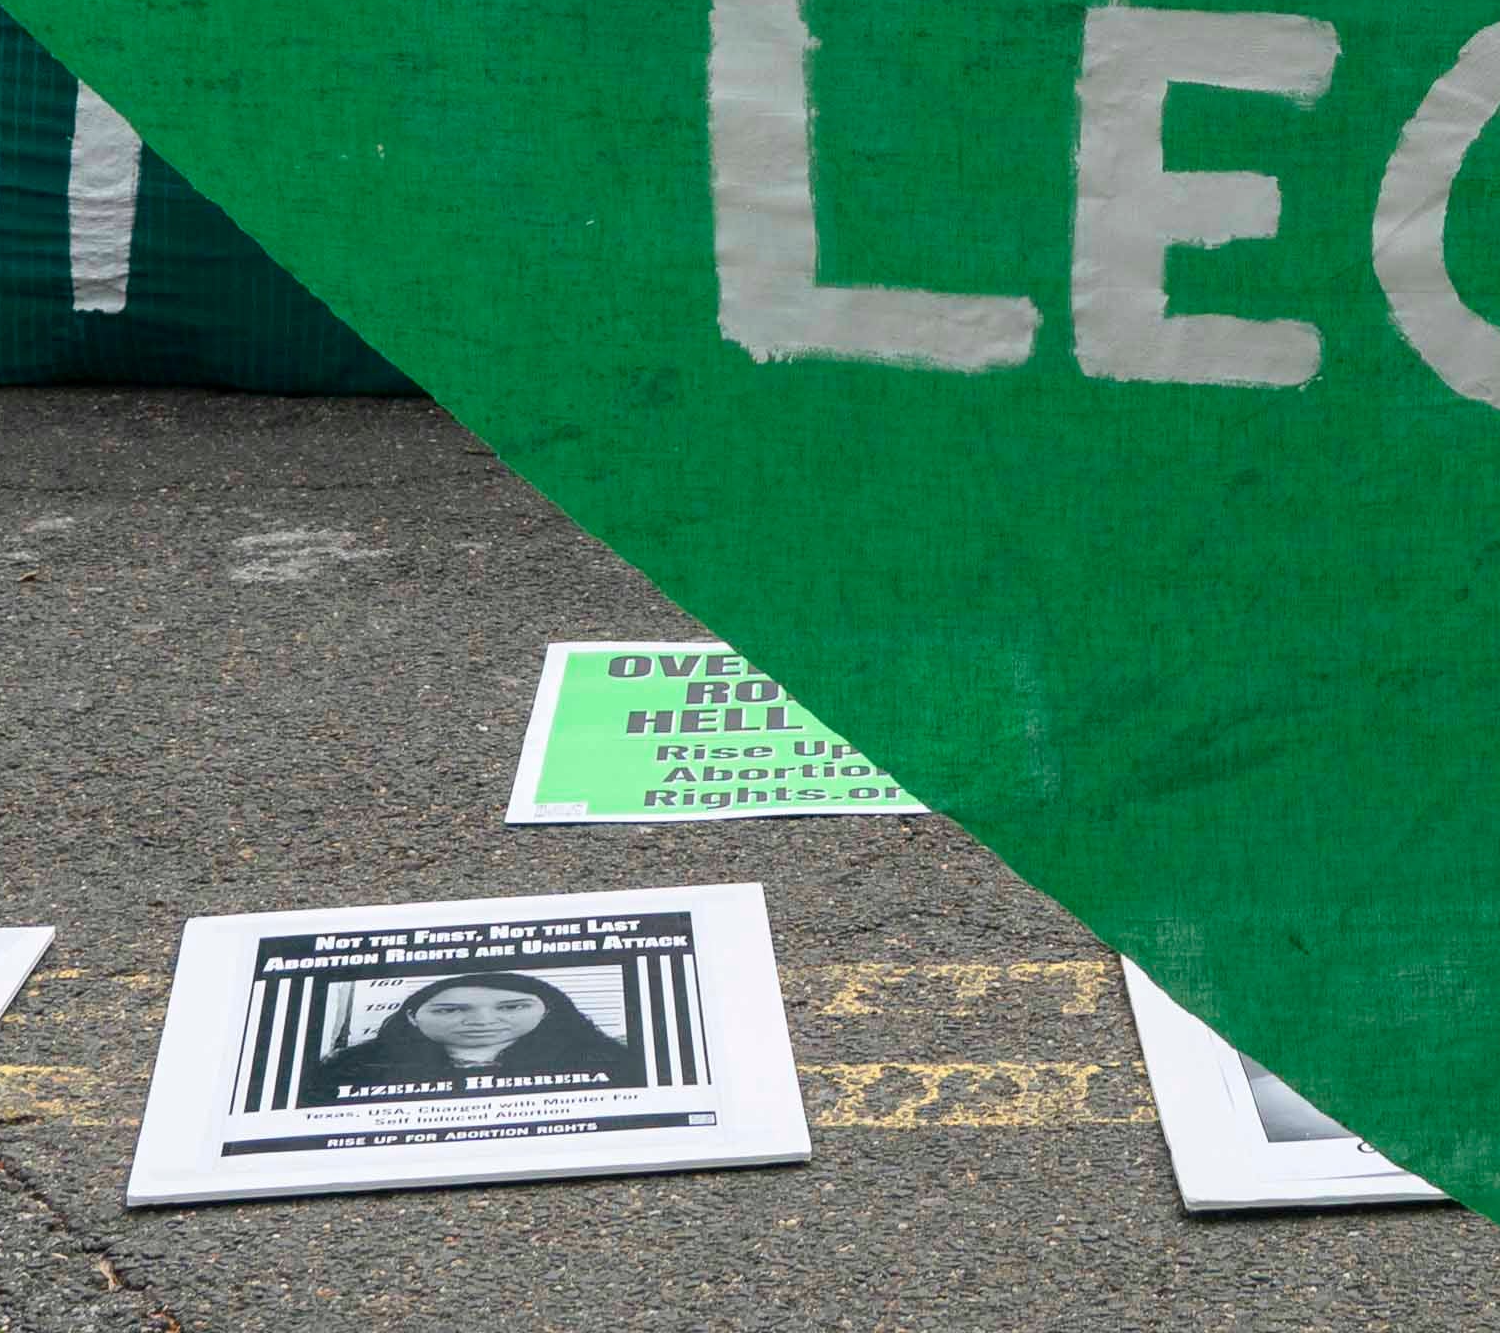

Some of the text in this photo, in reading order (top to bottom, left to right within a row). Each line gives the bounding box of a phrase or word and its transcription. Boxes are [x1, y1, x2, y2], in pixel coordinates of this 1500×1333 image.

[607, 654, 766, 679] OVE
[684, 680, 794, 706] RO
[625, 706, 804, 735] HELL
[655, 744, 774, 762] Rise
[662, 763, 890, 784] Abortio
[643, 785, 903, 811] Rights.or
[368, 977, 406, 988] 160
[363, 1002, 402, 1013] 150
[494, 1107, 571, 1120] Abortion
[499, 1100, 536, 1110] with
[326, 1121, 599, 1149] RISE UP FOR ABORTION RIGHTS
